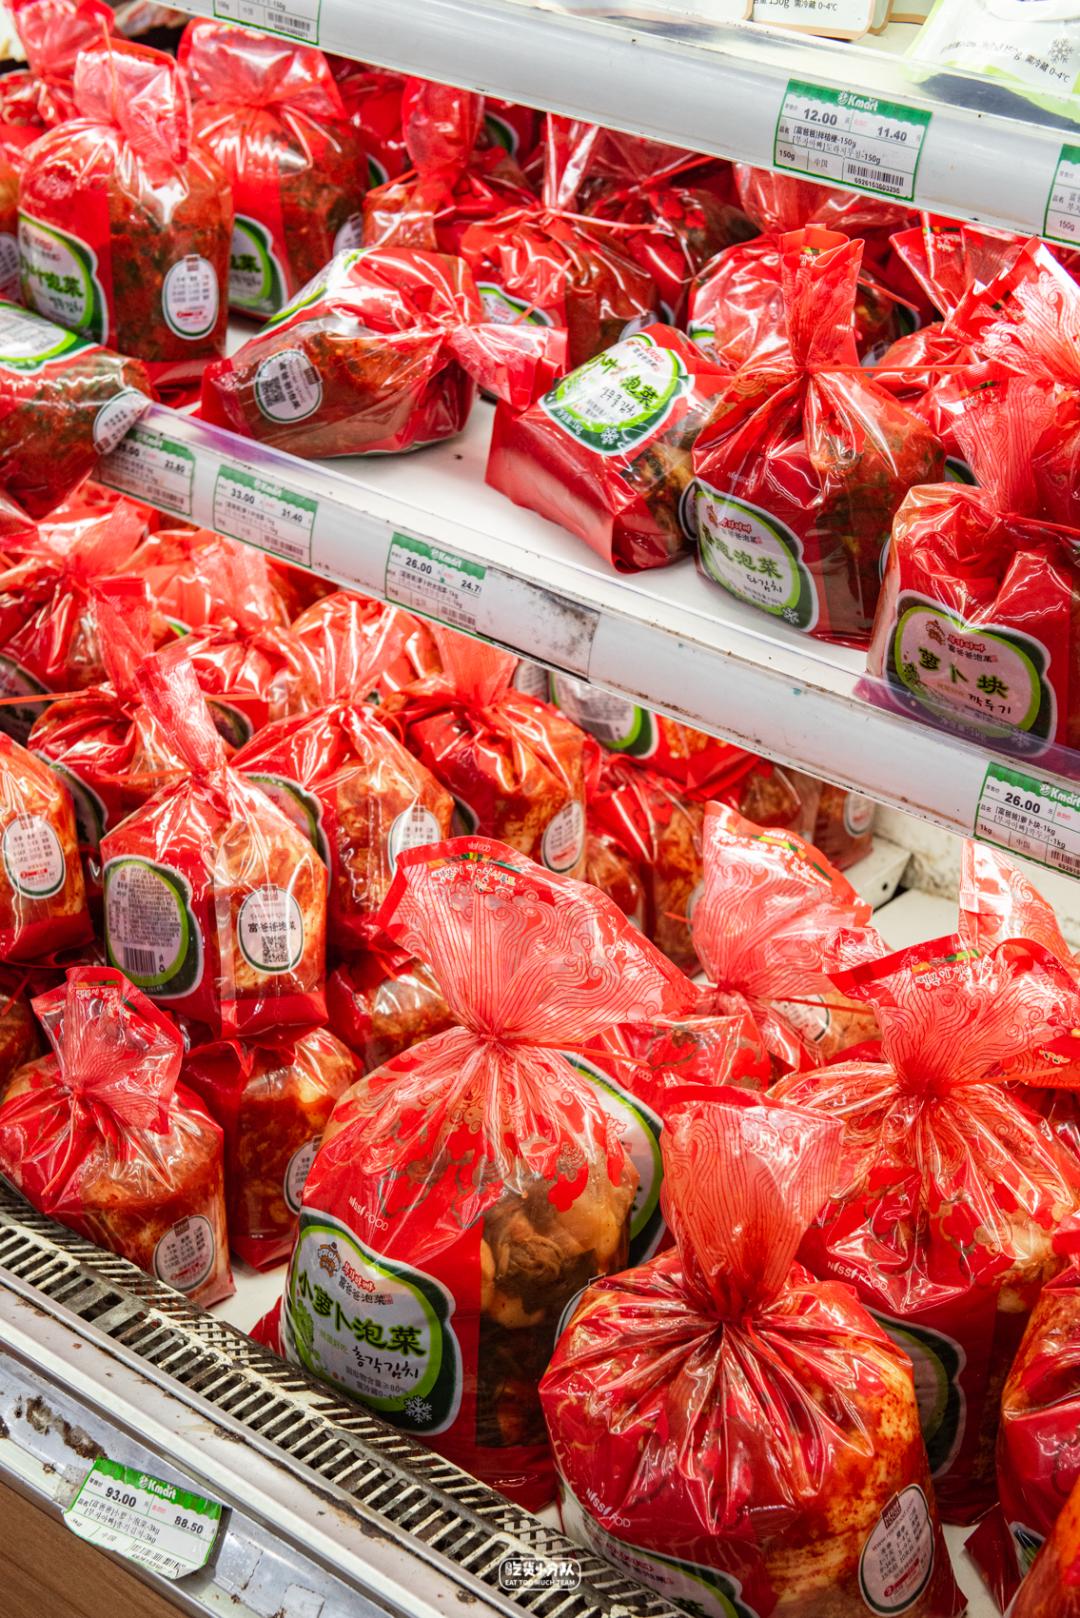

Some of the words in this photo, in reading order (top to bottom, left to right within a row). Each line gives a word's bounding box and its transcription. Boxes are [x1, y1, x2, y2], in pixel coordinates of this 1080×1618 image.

[848, 94, 879, 111] Kmart
[803, 108, 838, 126] 12.00
[877, 126, 907, 141] 11.40
[779, 149, 796, 161] 150g
[231, 488, 255, 505] 33.00
[405, 557, 432, 575] 26.00
[1004, 792, 1041, 814] 26.00
[980, 824, 993, 835] 1kg
[827, 1260, 858, 1278] NISSI
[858, 1273, 888, 1291] FOOD
[352, 1345, 419, 1380] 총각김치
[105, 1486, 136, 1508] 93.00
[148, 1479, 177, 1500] Kmart
[585, 1487, 612, 1515] NISSI
[174, 1515, 204, 1534] 88.50
